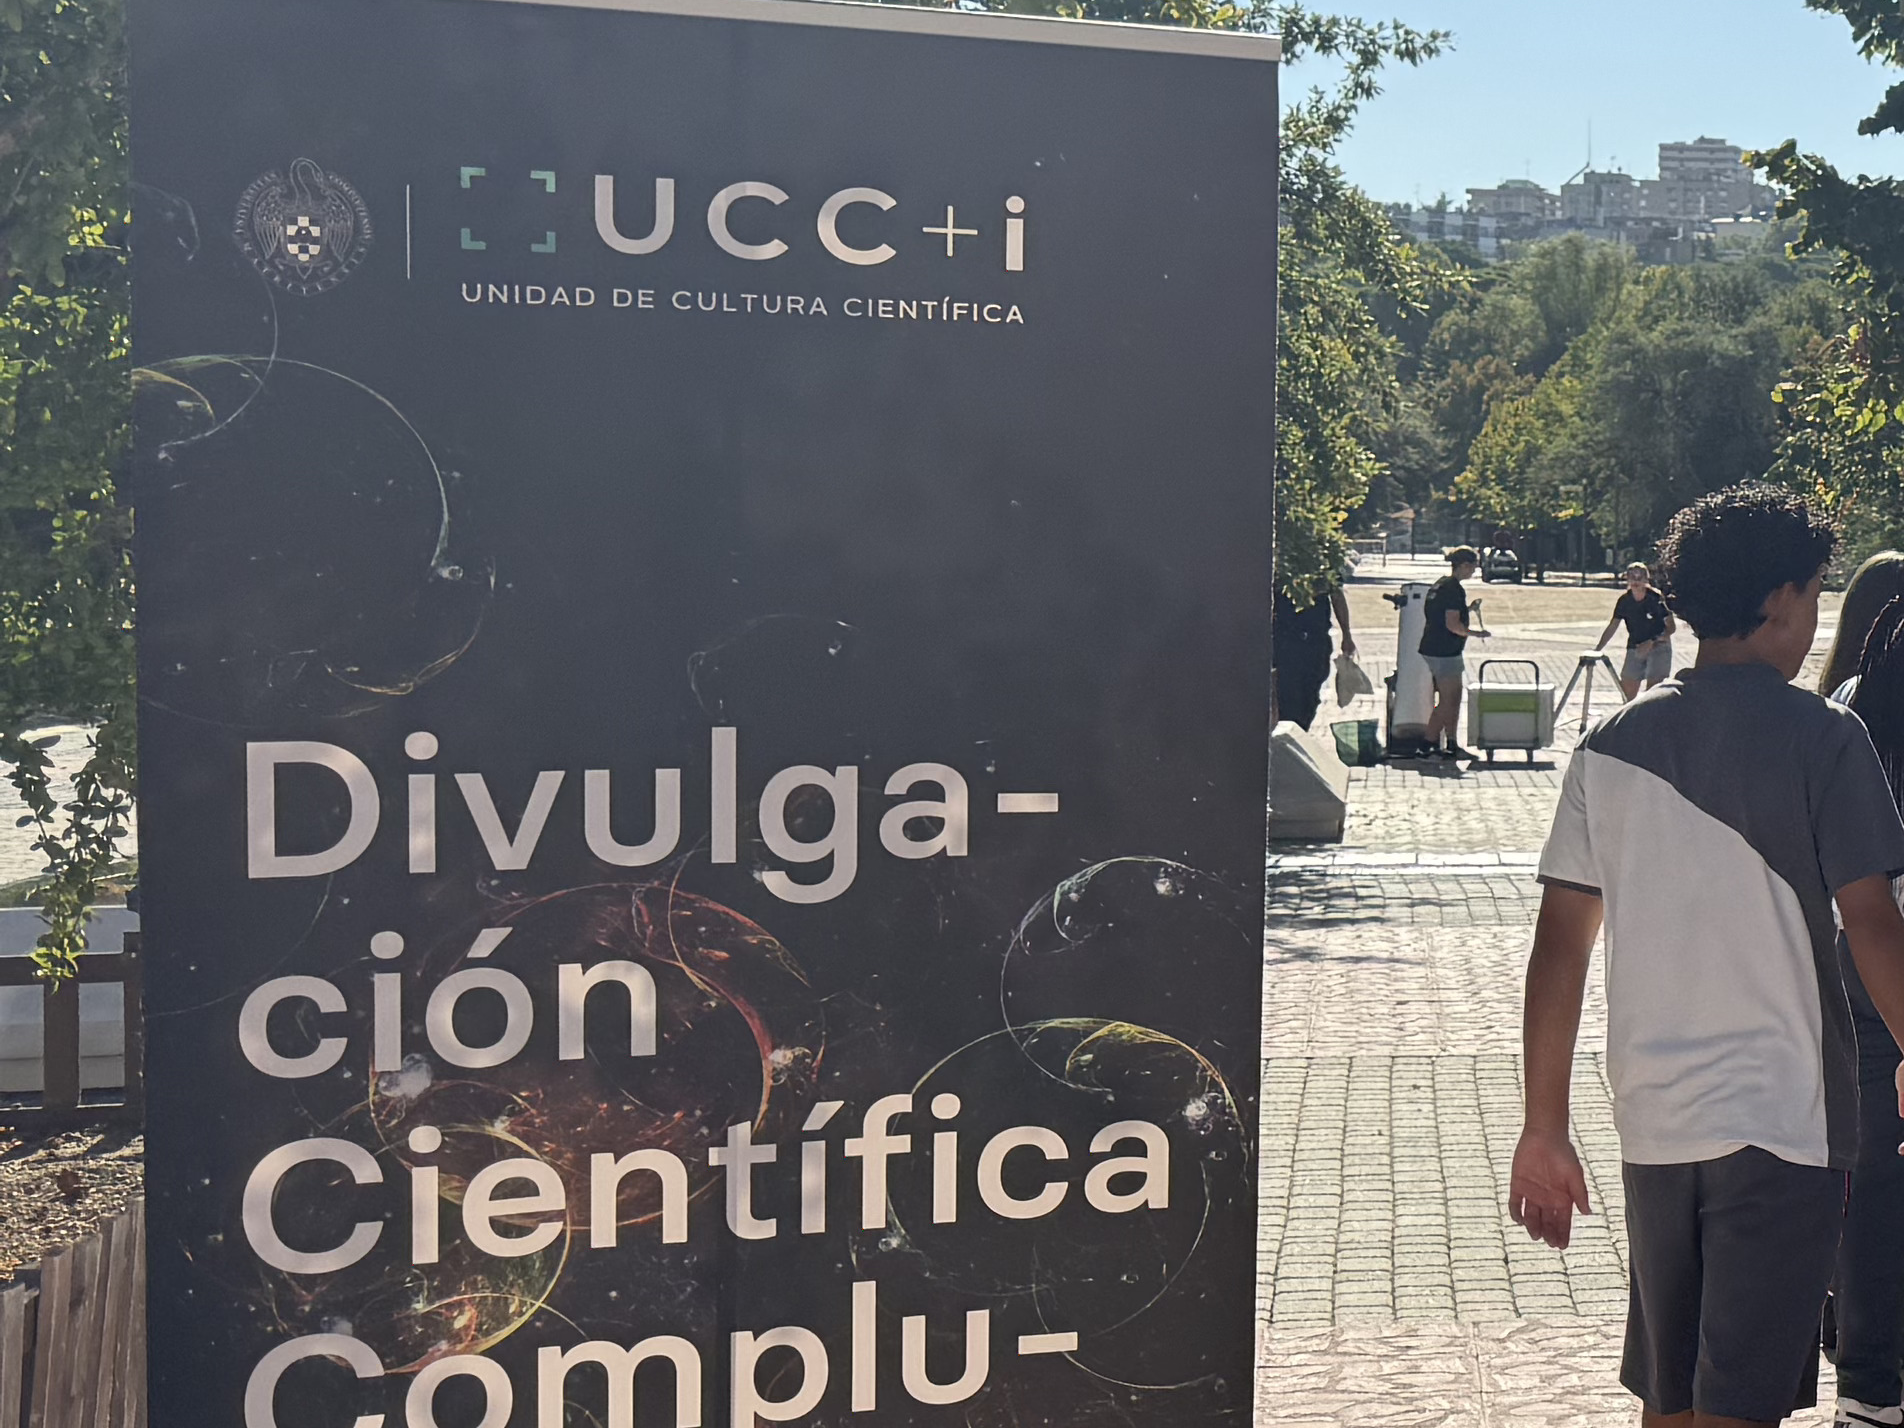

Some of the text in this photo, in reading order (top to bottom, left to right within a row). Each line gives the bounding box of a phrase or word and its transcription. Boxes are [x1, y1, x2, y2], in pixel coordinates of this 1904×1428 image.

[594, 174, 1025, 272] UCC+i
[461, 282, 1025, 324] UNIDAD DE CULTURA CIENTÍFICA
[245, 727, 1060, 903] Divulga-
[237, 927, 658, 1078] ción
[240, 1094, 1172, 1274] Científica
